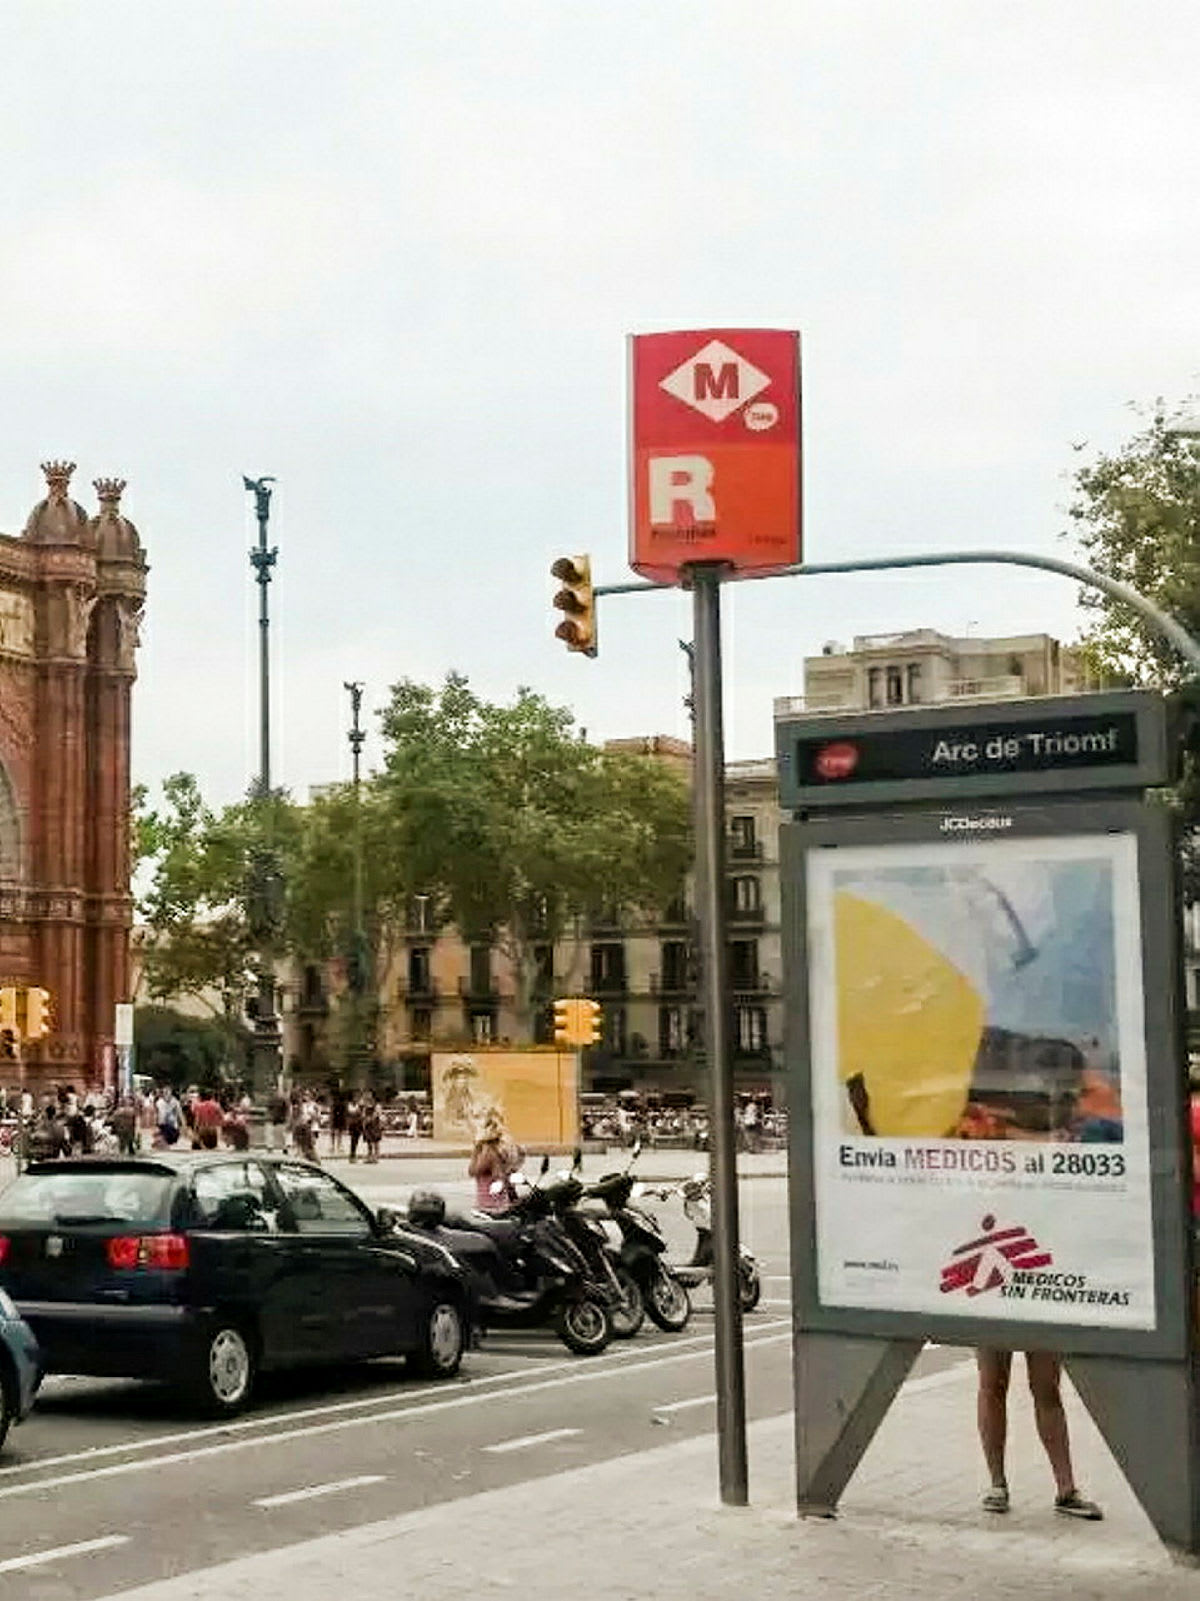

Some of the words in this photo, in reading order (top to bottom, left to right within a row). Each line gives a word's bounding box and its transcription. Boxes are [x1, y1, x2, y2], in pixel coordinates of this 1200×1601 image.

[693, 363, 740, 400] M
[649, 455, 717, 524] R
[932, 741, 979, 762] Arc
[985, 736, 1020, 759] de
[1026, 727, 1119, 755] Triomf
[904, 1149, 1017, 1173] MEDICOS
[1024, 1151, 1044, 1174] al
[1052, 1152, 1126, 1176] 28033
[999, 1285, 1026, 1299] SIN
[1031, 1287, 1131, 1306] FRONTERAS
[1012, 1271, 1087, 1289] MEDICOS
